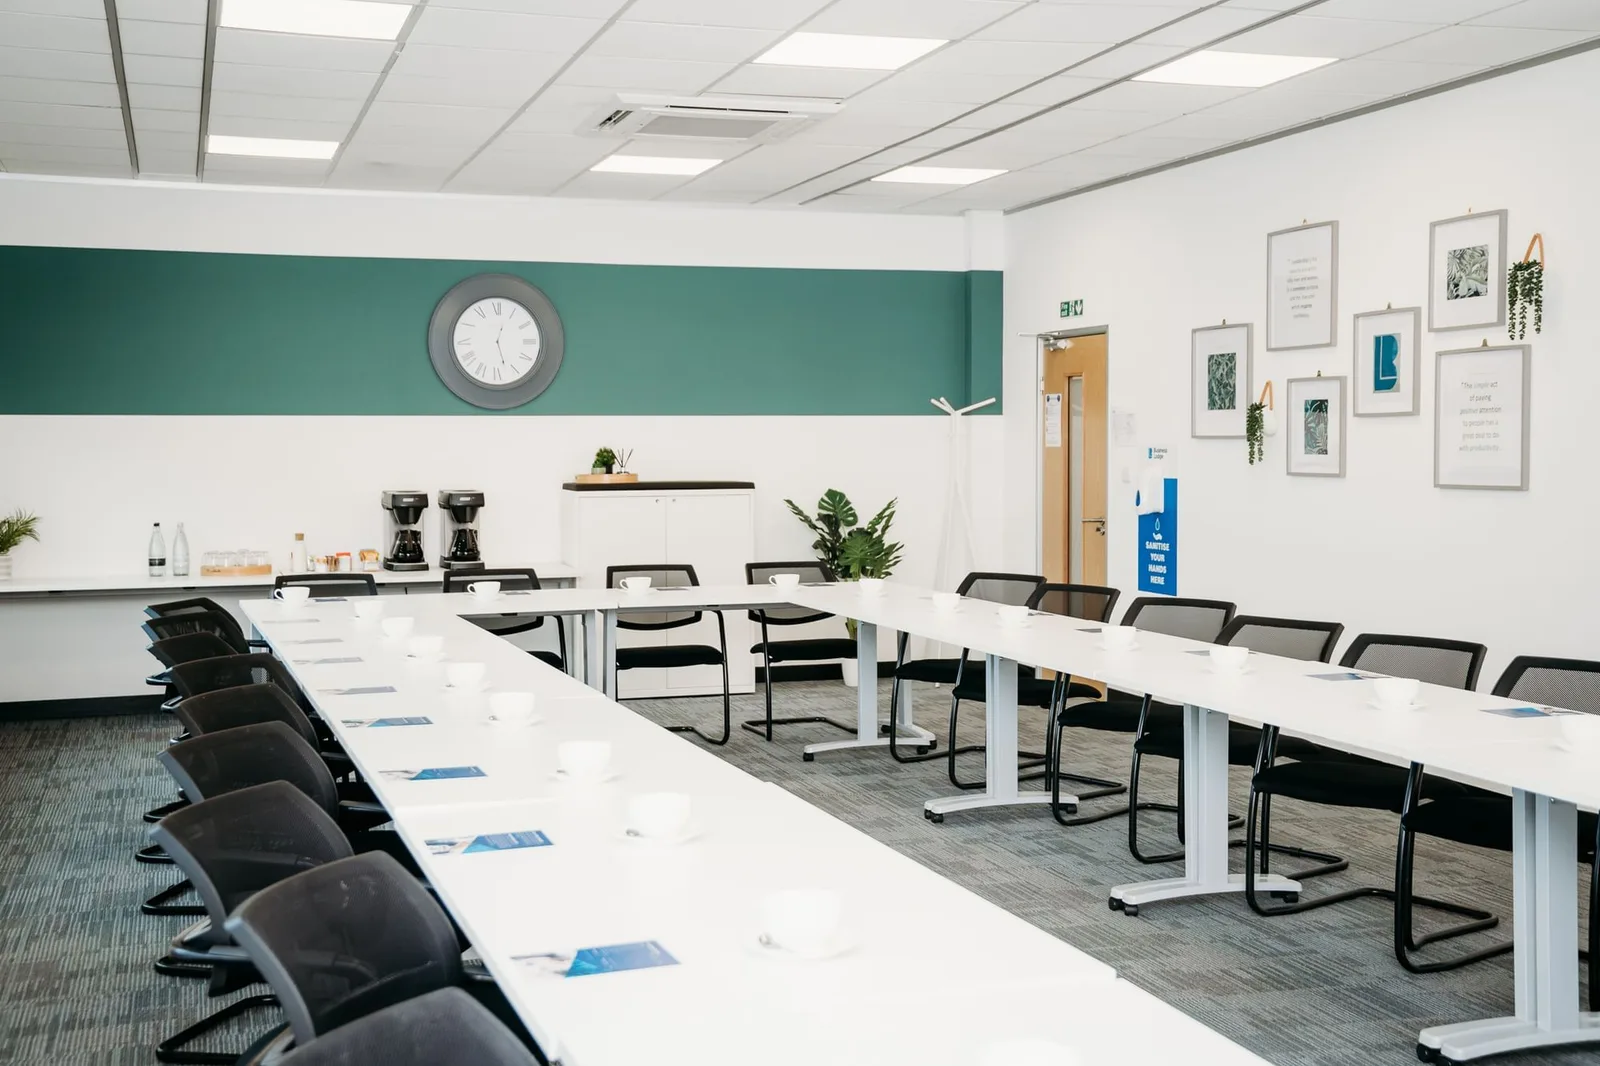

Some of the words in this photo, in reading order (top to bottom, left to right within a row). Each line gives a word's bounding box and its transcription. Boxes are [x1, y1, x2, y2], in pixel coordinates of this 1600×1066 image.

[1145, 541, 1170, 551] SANITISE
[1150, 553, 1165, 562] YOUR
[1148, 564, 1167, 574] HANDS
[1150, 575, 1165, 585] HERE
